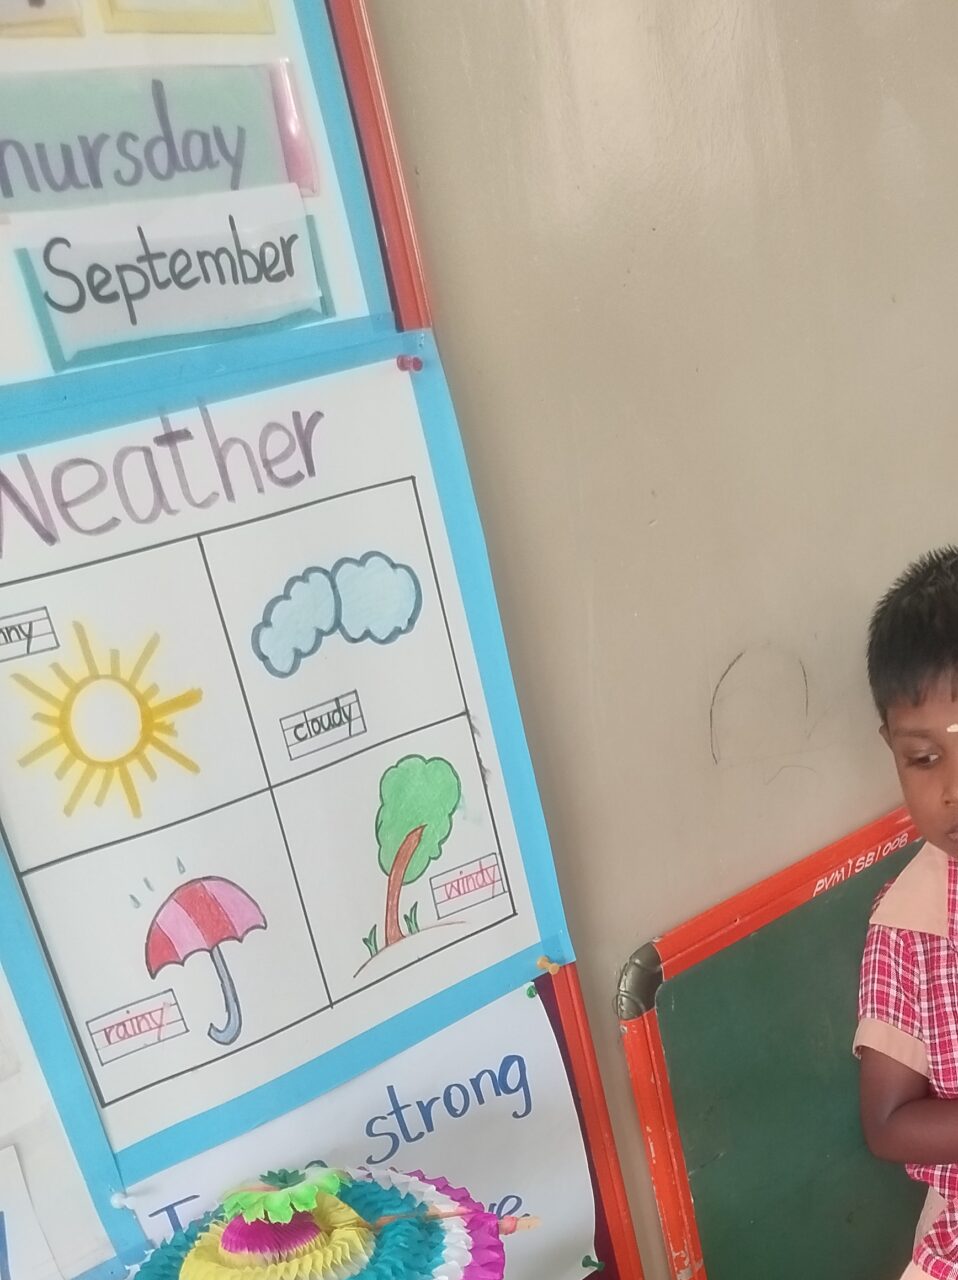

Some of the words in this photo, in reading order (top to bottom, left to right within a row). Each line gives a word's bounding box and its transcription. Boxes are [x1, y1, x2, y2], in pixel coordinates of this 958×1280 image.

[42, 214, 300, 326] September
[293, 697, 353, 742] cloudy
[444, 859, 497, 898] windy
[103, 1006, 165, 1046] rainy
[364, 1053, 533, 1165] strong
